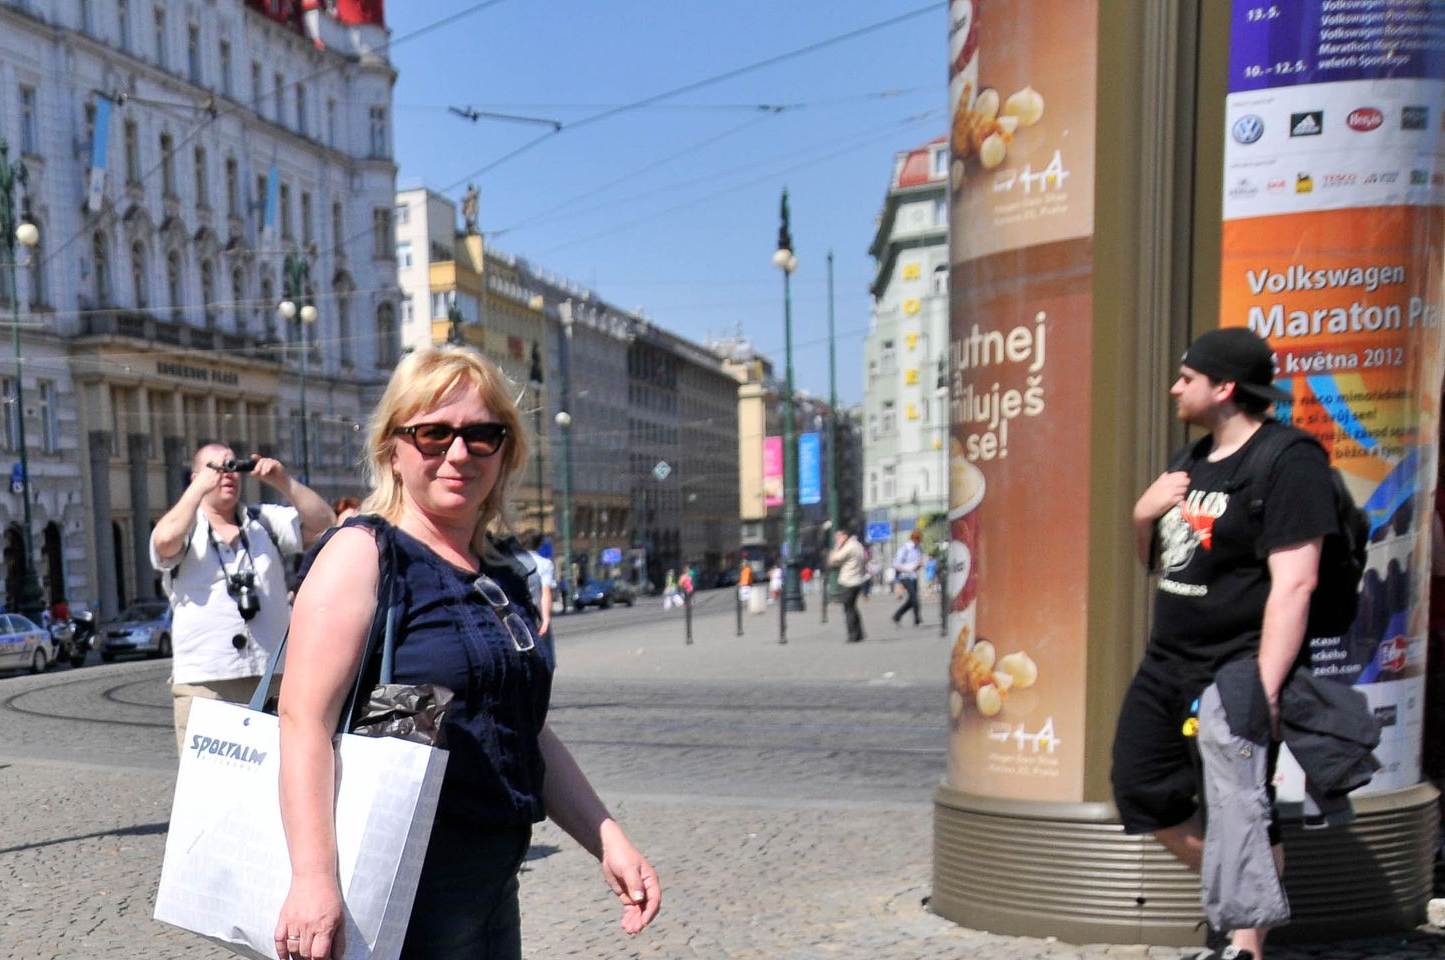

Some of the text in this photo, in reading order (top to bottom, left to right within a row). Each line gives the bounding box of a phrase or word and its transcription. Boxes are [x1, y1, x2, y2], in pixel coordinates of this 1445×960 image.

[1246, 264, 1405, 296] Volkswagen
[1247, 301, 1401, 339] Maraton
[903, 262, 921, 420] HOTEL
[1285, 351, 1358, 374] května
[1363, 347, 1404, 369] 2012
[966, 418, 1008, 462] se!
[190, 734, 267, 767] SPORTALM
